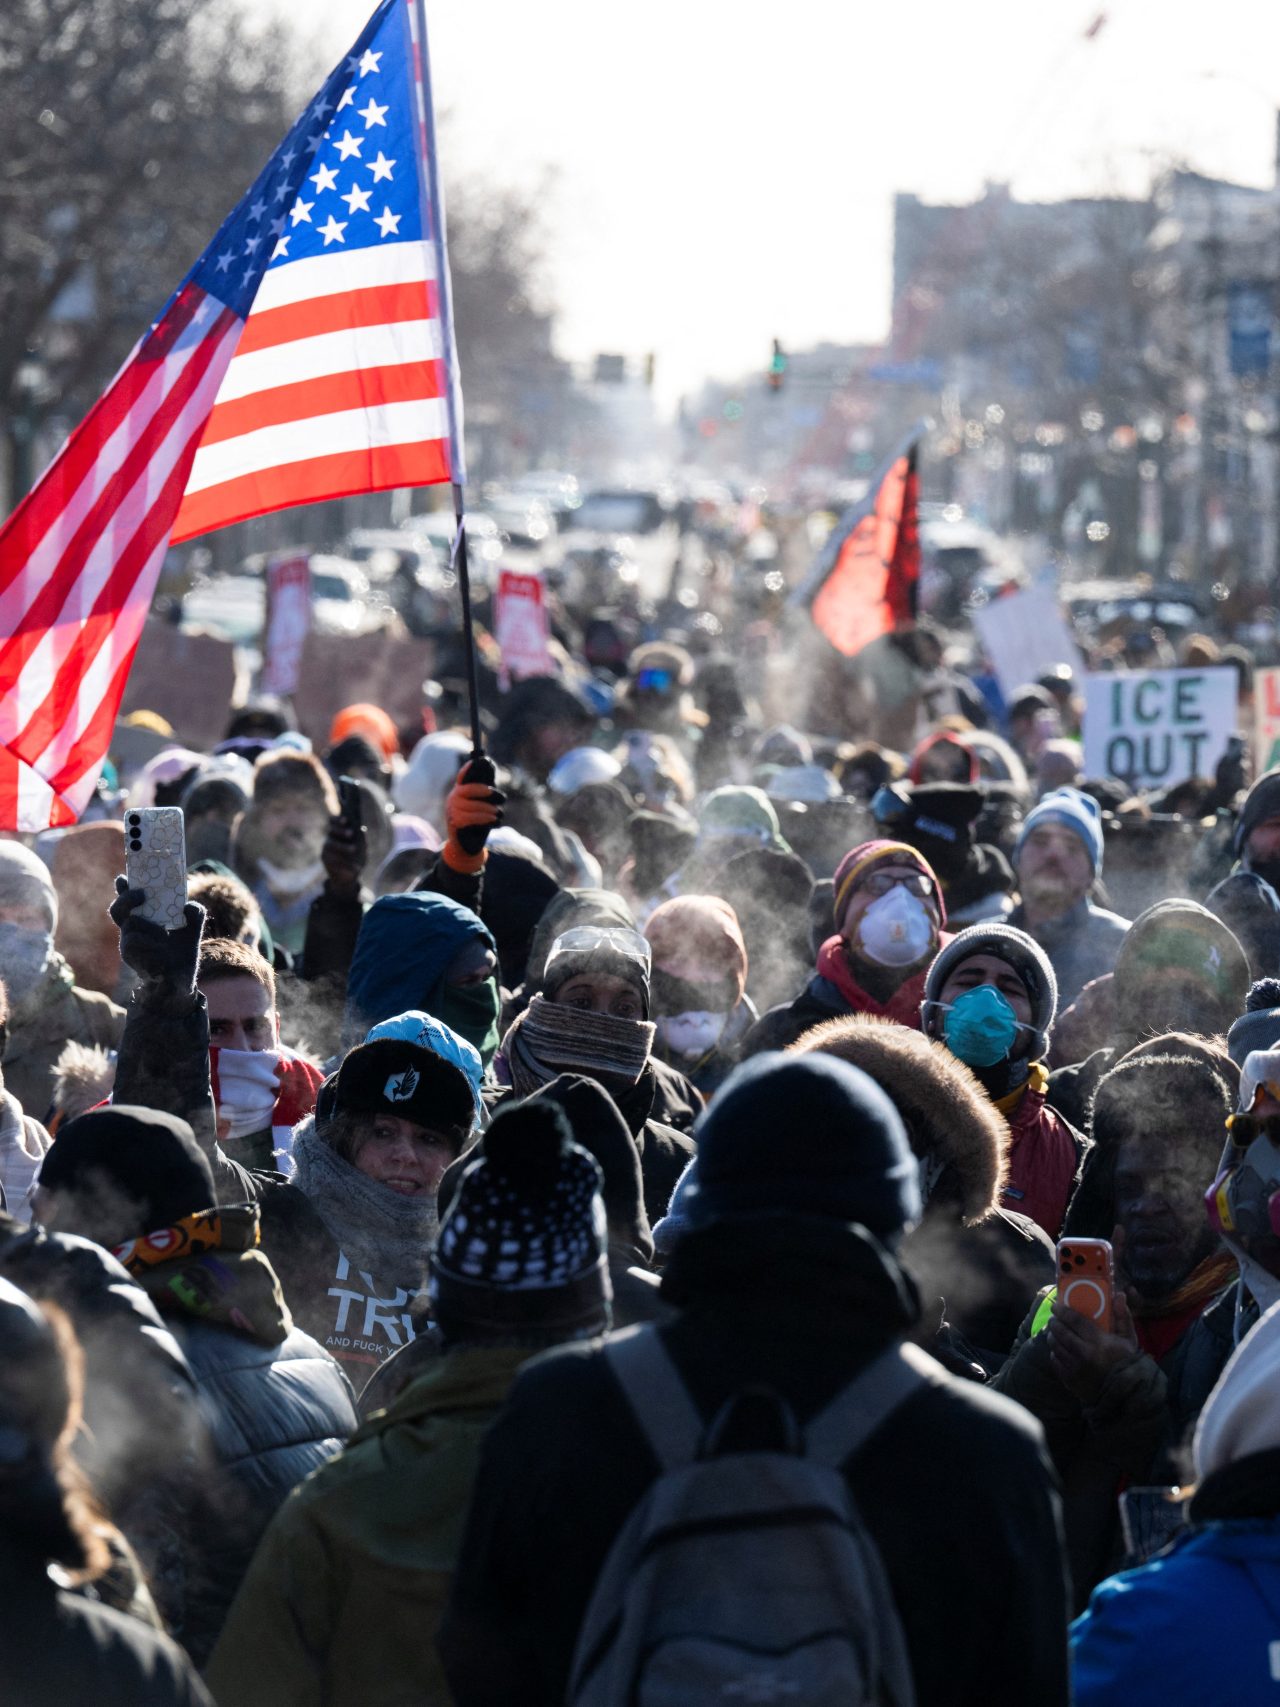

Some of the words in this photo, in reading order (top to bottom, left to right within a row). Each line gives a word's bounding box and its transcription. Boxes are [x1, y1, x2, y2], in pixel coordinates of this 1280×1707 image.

[1111, 677, 1205, 728] ICE
[1106, 731, 1208, 780] OUT
[326, 1336, 350, 1347] AND
[353, 1340, 384, 1354] FUCK
